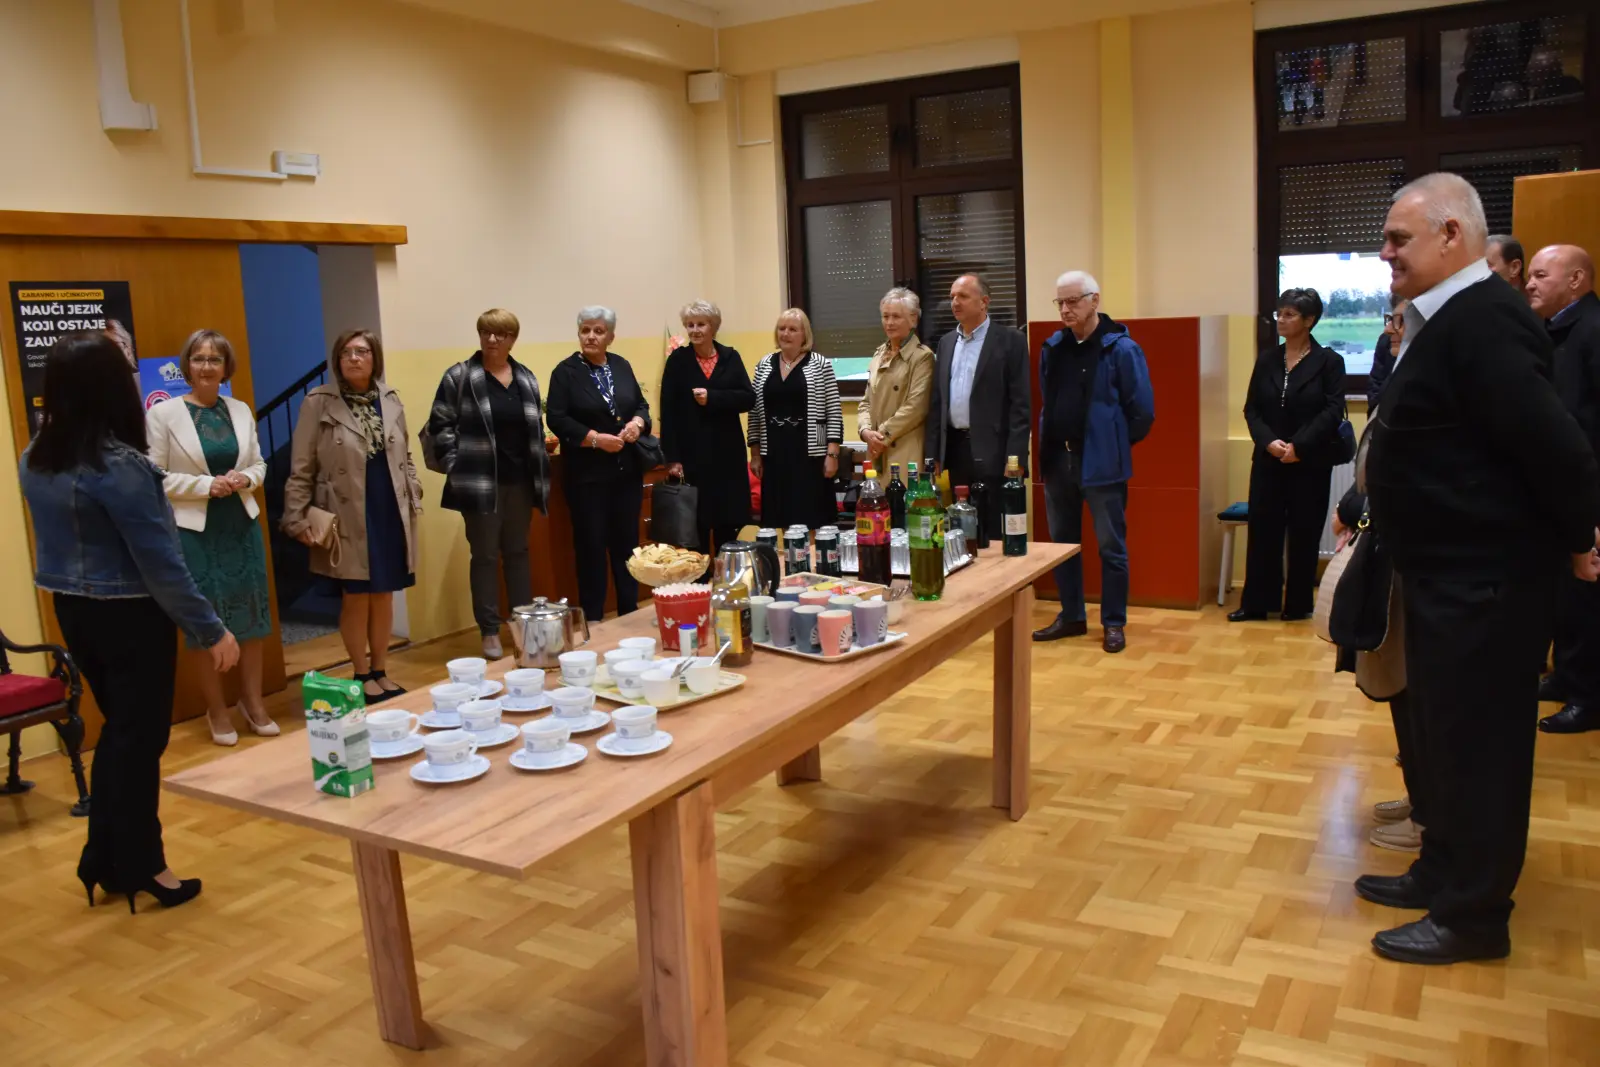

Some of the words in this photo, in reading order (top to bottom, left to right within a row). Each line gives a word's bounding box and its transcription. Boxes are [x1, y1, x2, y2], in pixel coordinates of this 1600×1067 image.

[21, 302, 64, 315] NAUČI
[67, 304, 103, 314] JEZIK
[23, 321, 54, 331] KOJI
[57, 319, 106, 330] OSTAJE
[24, 336, 61, 347] ZAUV
